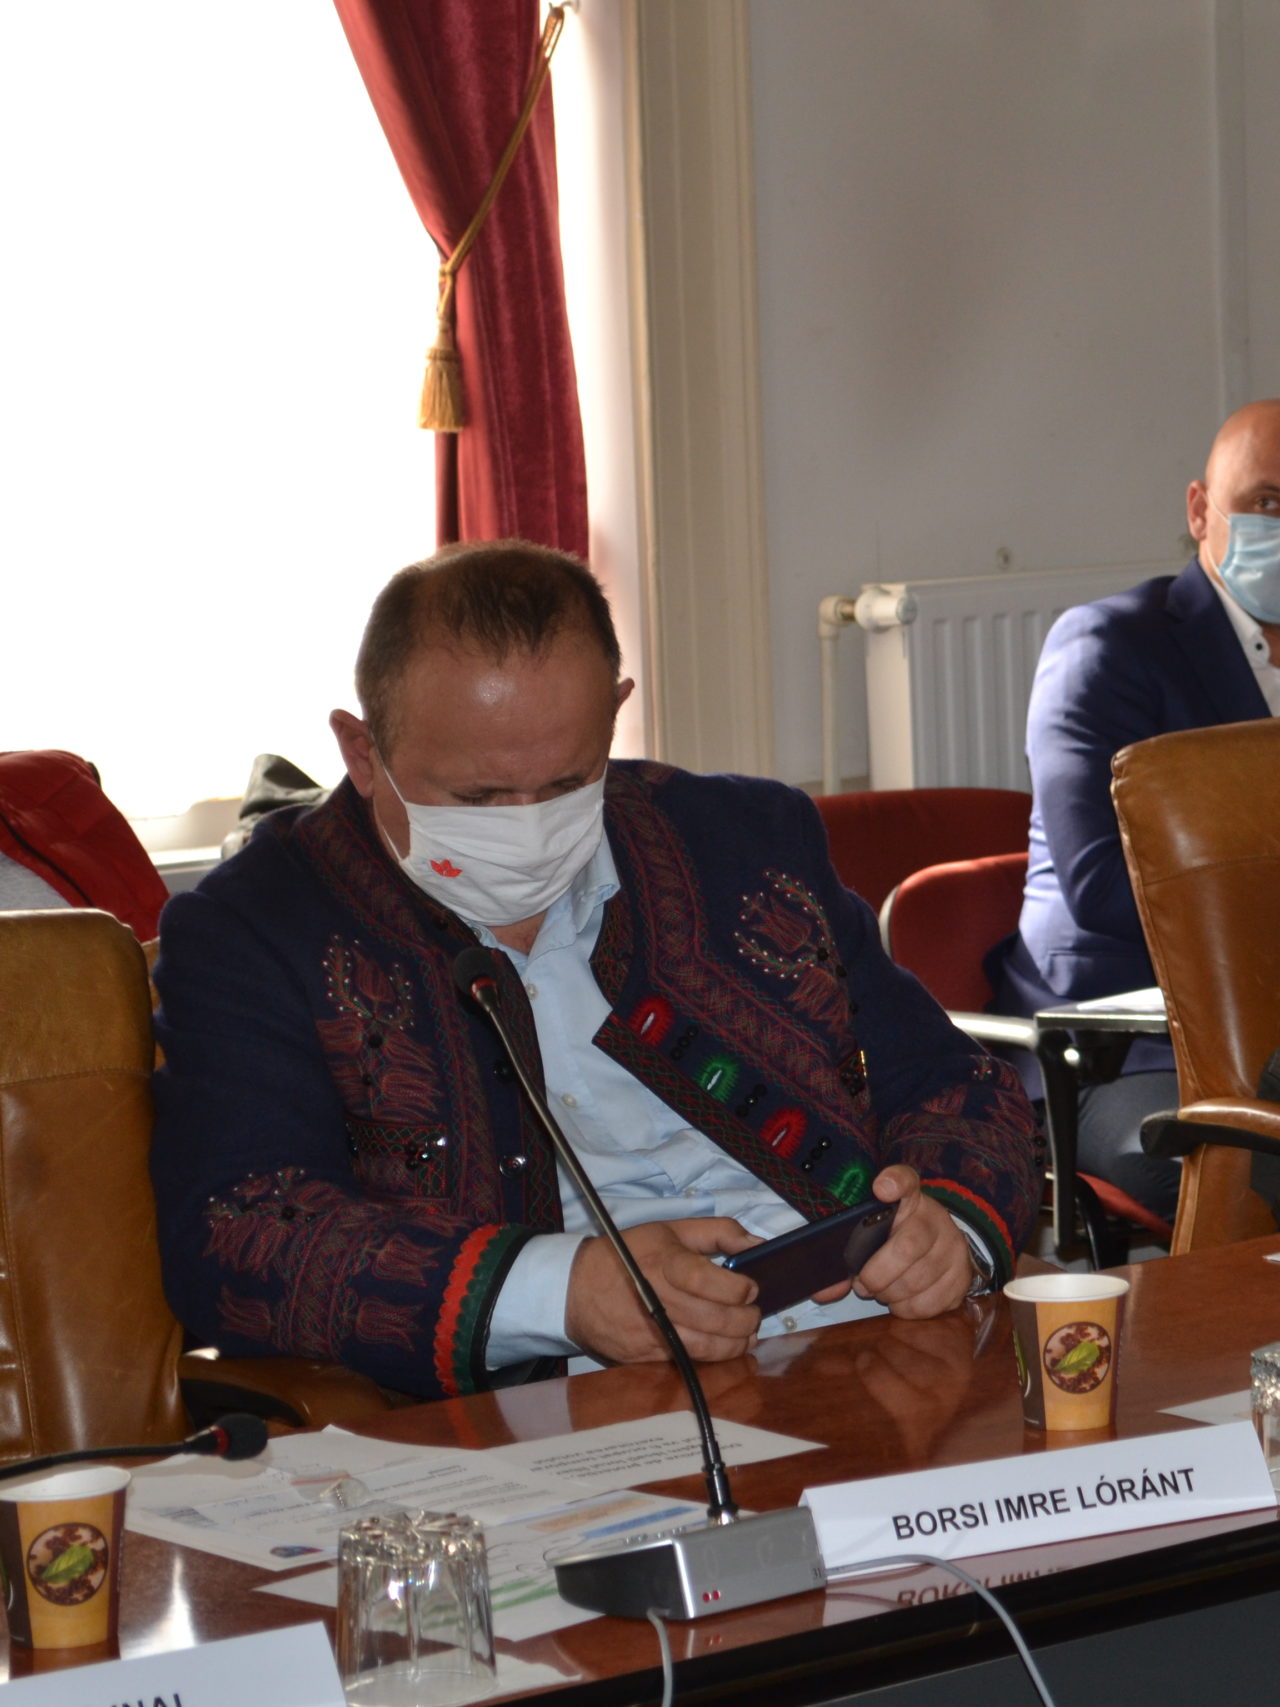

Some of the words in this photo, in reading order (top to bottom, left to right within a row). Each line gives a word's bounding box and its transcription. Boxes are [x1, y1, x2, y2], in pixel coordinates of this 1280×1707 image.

[892, 1501, 989, 1540] BORSI
[994, 1488, 1071, 1524] IMRE
[1076, 1467, 1195, 1511] LÓRÁNT
